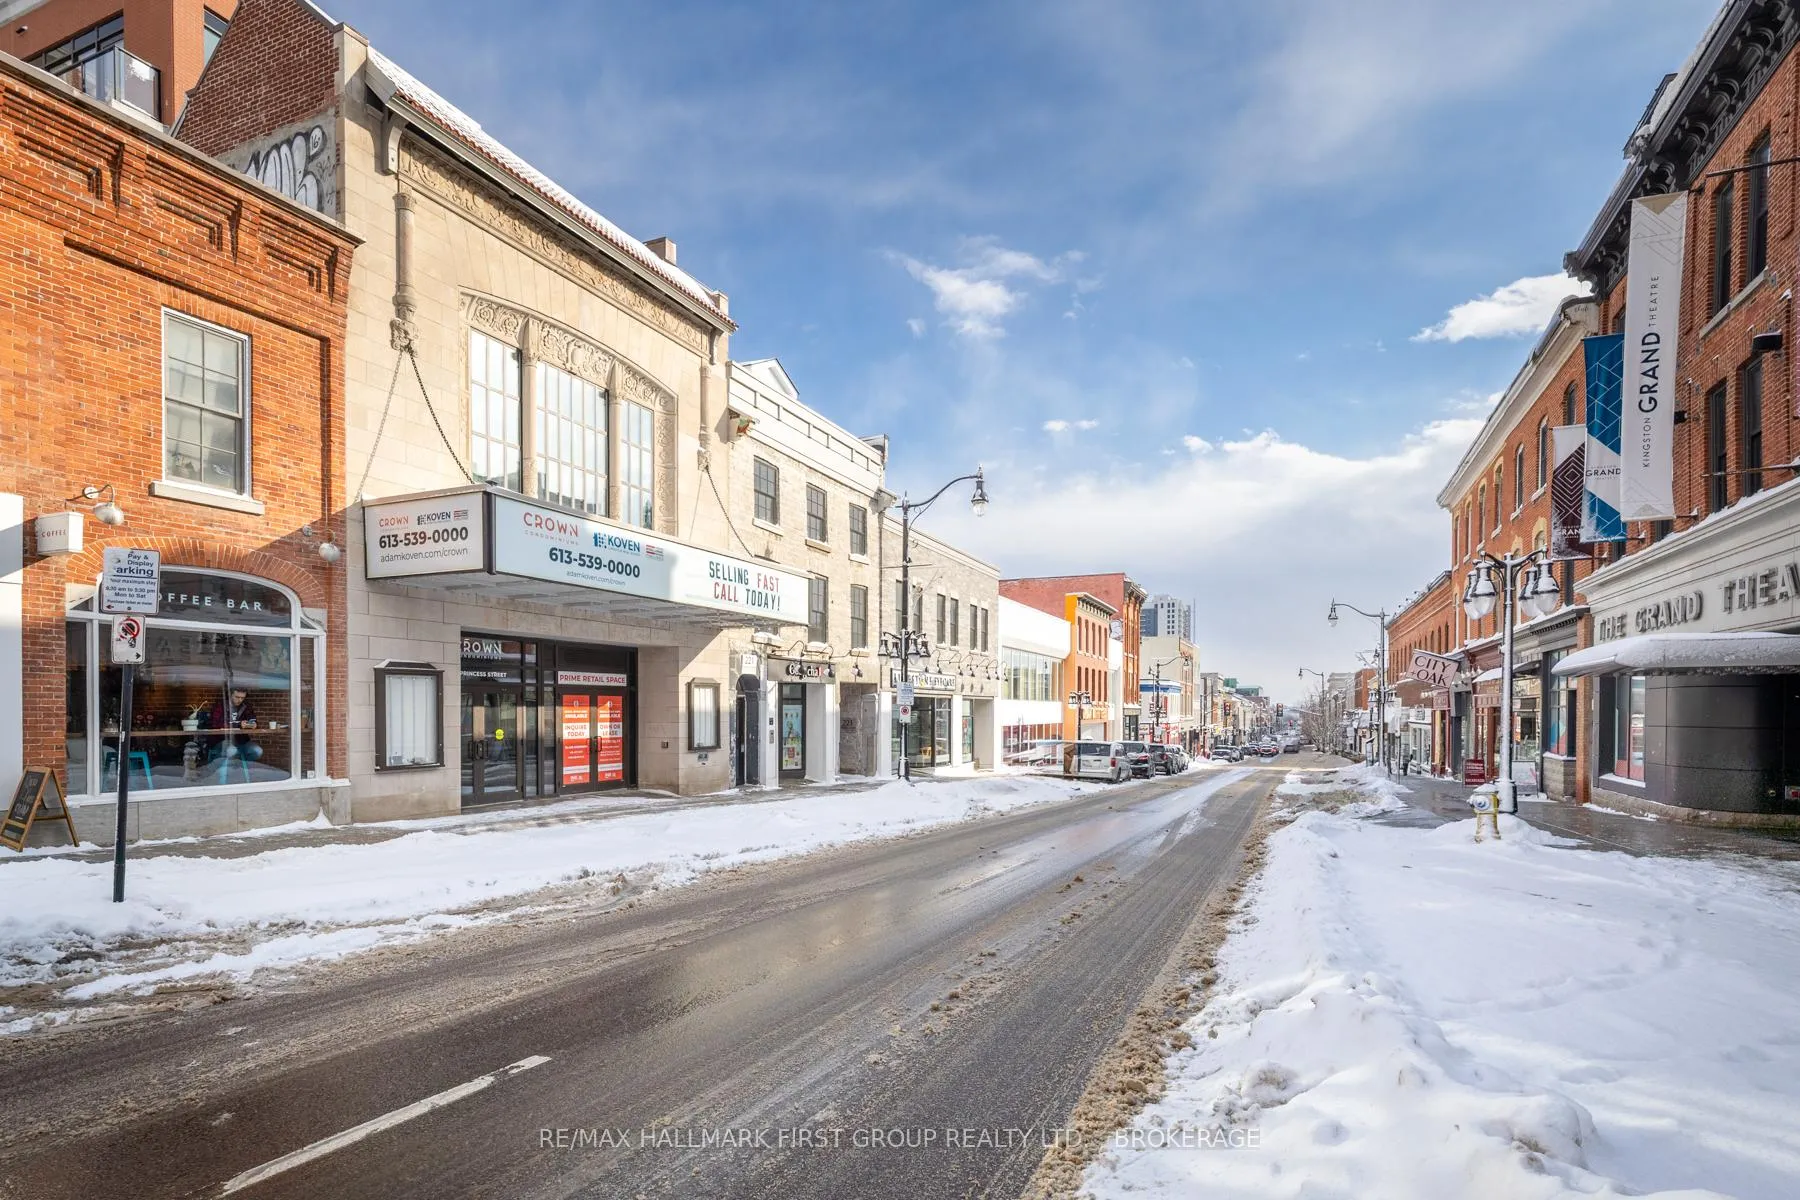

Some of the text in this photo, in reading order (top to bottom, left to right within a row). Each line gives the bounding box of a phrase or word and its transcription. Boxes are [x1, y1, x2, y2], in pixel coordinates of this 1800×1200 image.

[1638, 276, 1661, 468] KINGSTON GRAND THEATRE
[379, 515, 409, 527] CROWN
[426, 511, 451, 521] KOVEN
[41, 529, 67, 538] COFFEE
[379, 526, 469, 549] 613-539-0000
[523, 512, 579, 537] CROWN
[607, 535, 641, 553] KOVEN
[380, 548, 468, 563] adamkoven.com/crown
[549, 546, 640, 578] 613-539-0000
[113, 566, 154, 577] arking
[566, 570, 626, 587] adamkoven.com/crown
[709, 561, 780, 592] SELLING FAST
[226, 598, 262, 611] BAR
[714, 582, 780, 611] CALL TODAY!
[1600, 611, 1627, 641] THE
[1634, 591, 1704, 634] GRAND
[463, 638, 502, 654] ROWN
[1414, 655, 1451, 673] CITY
[559, 674, 626, 684] PRIME RETAIL SPACE
